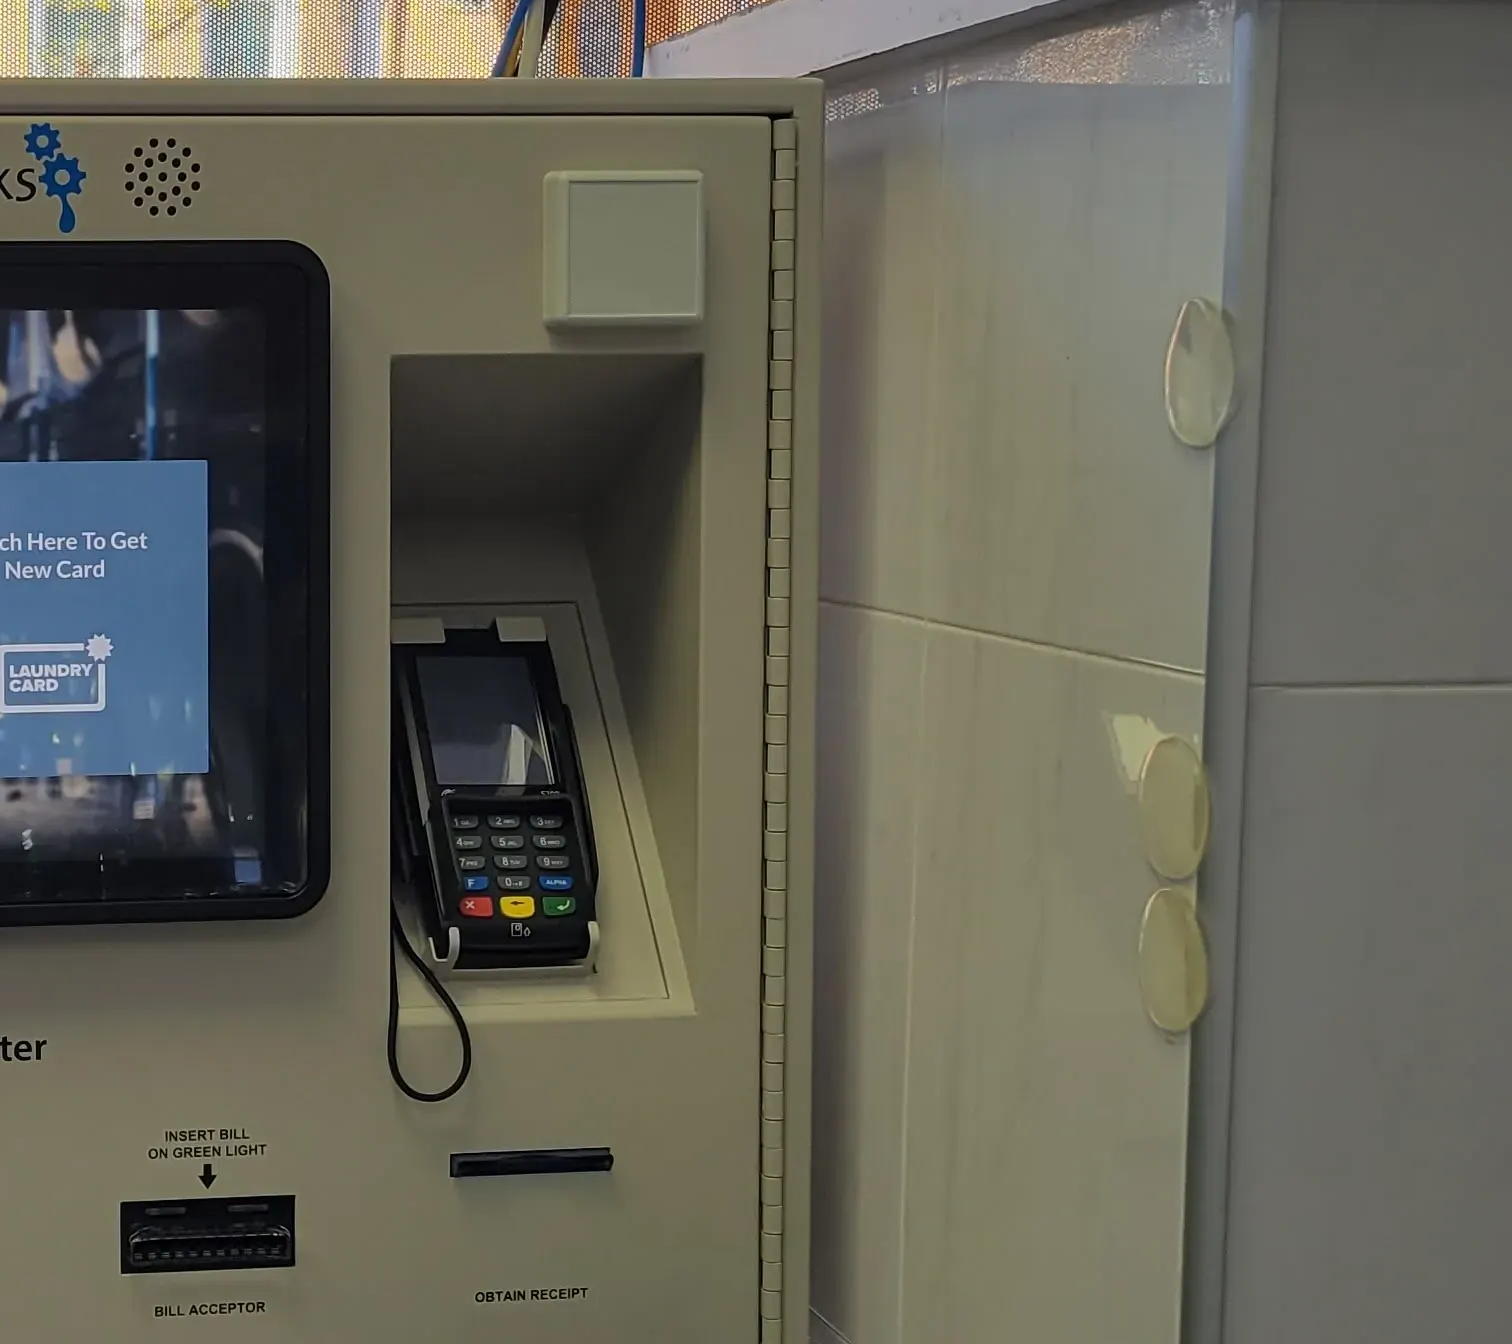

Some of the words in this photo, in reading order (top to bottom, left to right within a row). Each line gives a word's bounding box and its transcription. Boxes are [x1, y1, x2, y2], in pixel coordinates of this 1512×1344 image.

[27, 533, 78, 551] Here
[82, 532, 106, 550] To
[110, 531, 148, 550] Get
[4, 561, 52, 580] New
[56, 560, 105, 579] Card
[9, 664, 93, 678] LAUNDRY
[9, 678, 59, 692] CARD
[495, 816, 503, 825] 2
[537, 817, 544, 826] 3
[456, 837, 463, 846] 4
[499, 837, 506, 846] 5
[540, 837, 547, 846] 6
[458, 857, 465, 867] 7
[502, 856, 509, 866] 8
[543, 857, 550, 866] 9
[467, 879, 475, 888] F
[505, 877, 512, 887] 0
[164, 1129, 216, 1142] INSERT
[219, 1128, 250, 1140] BILL
[148, 1147, 169, 1159] ON
[172, 1146, 222, 1159] GREEN
[225, 1144, 268, 1157] LIGHT
[474, 1290, 526, 1303] OBTAIN
[530, 1287, 589, 1301] RECEIPT
[154, 1305, 185, 1318] BILL
[189, 1301, 266, 1316] ACCEPTOR
